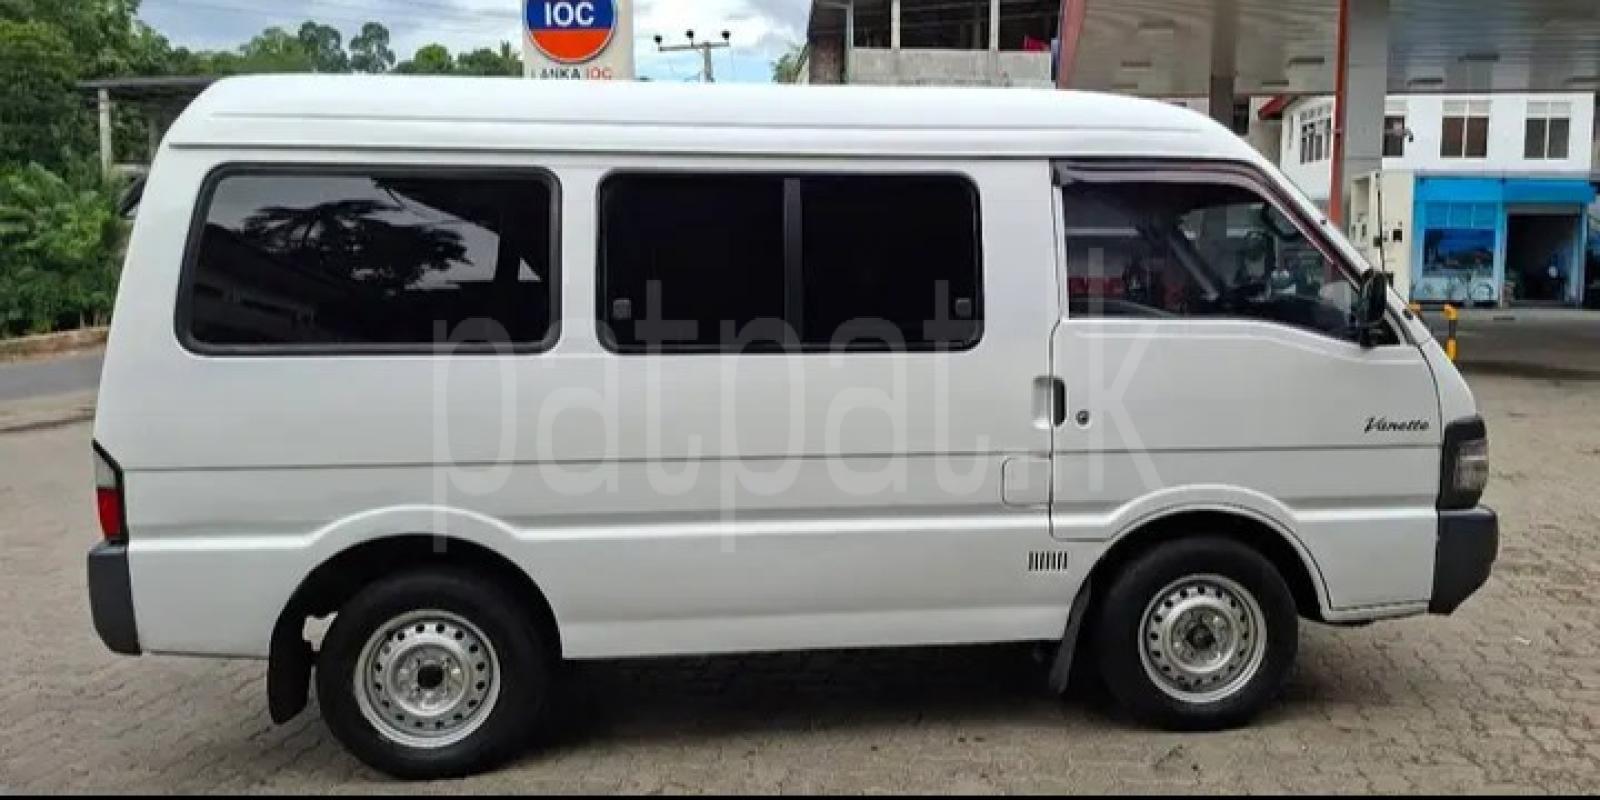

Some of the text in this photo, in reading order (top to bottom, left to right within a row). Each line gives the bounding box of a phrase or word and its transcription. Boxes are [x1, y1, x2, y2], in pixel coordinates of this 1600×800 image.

[544, 1, 595, 27] IOC
[586, 66, 612, 80] IOC
[1364, 417, 1430, 433] Vanette
